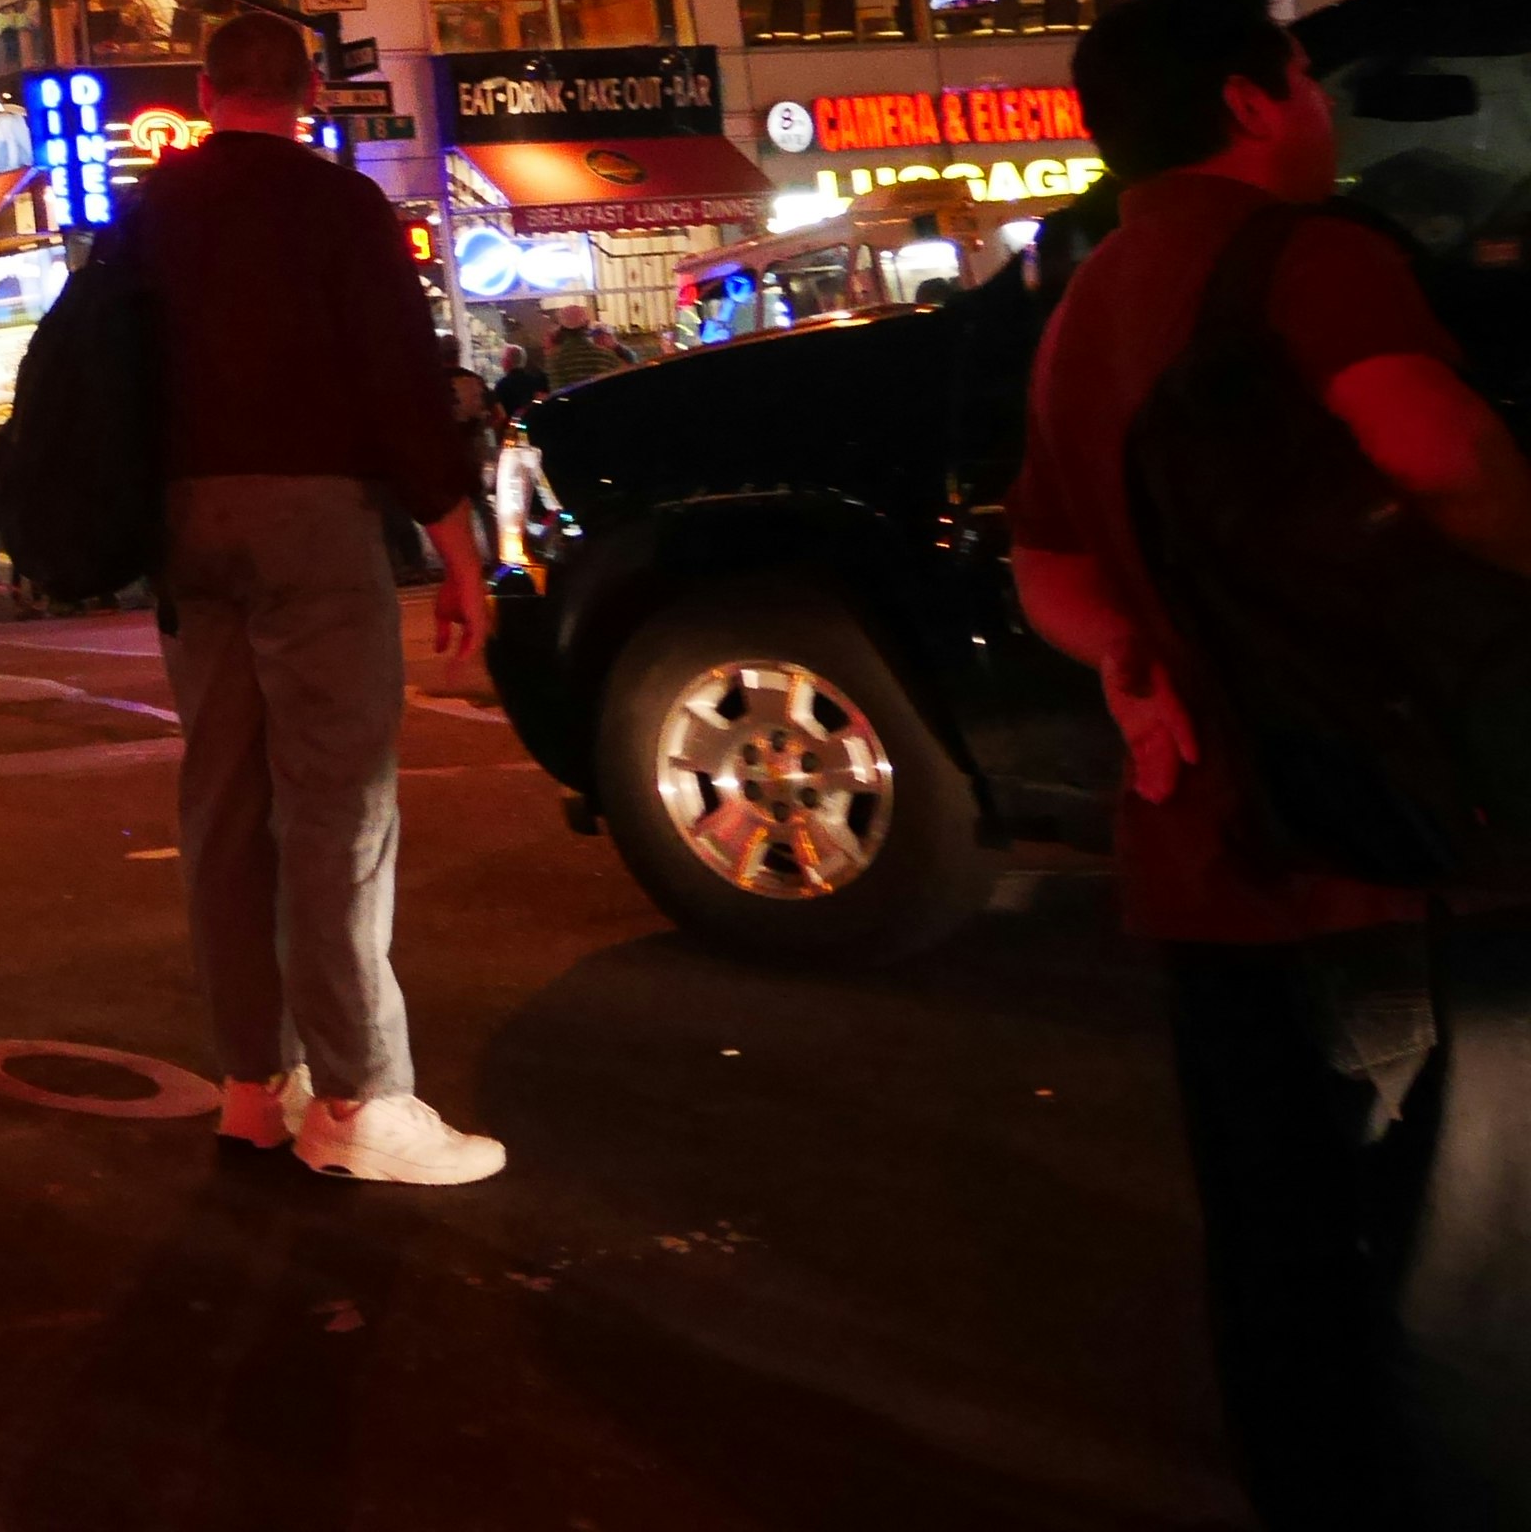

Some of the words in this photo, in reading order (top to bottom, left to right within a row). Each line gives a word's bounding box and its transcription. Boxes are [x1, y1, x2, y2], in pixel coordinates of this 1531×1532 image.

[458, 80, 497, 116] EAT
[506, 76, 567, 115] DRINK
[574, 76, 621, 111] TAKE
[623, 75, 663, 110] OUT
[673, 73, 713, 108] BAR
[814, 92, 940, 152] CAMERA
[942, 92, 970, 144] &
[71, 73, 111, 225] DINER
[525, 203, 626, 228] BREAKFAST
[635, 200, 695, 222] LUNCH
[411, 225, 430, 262] 9
